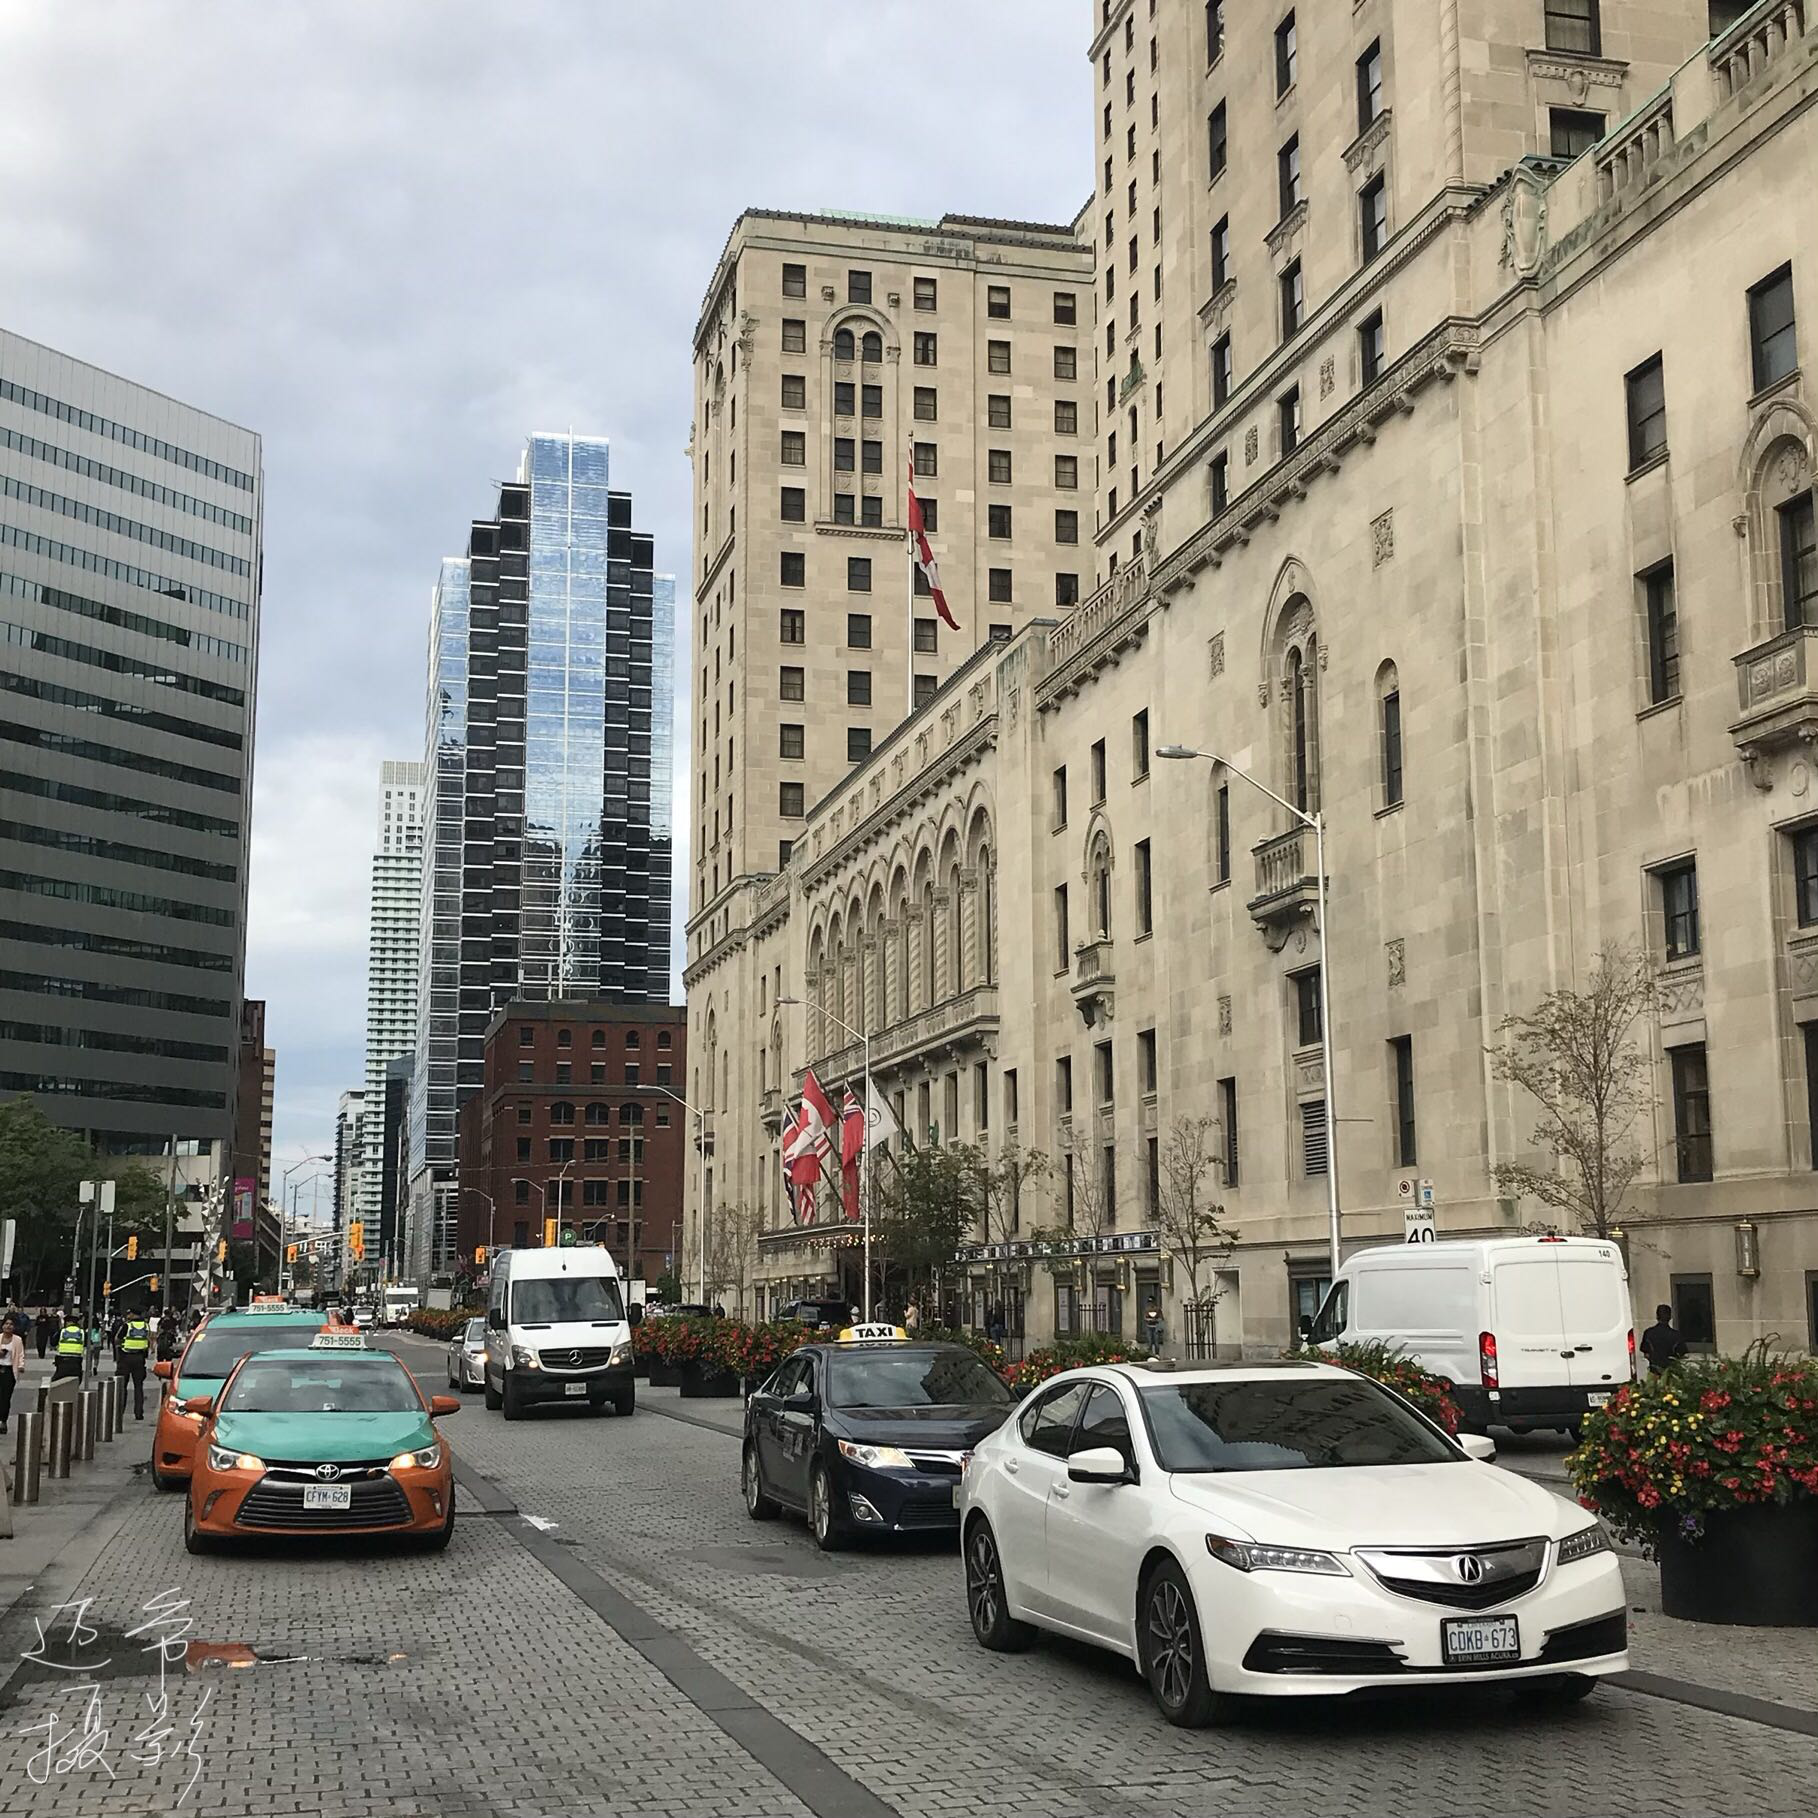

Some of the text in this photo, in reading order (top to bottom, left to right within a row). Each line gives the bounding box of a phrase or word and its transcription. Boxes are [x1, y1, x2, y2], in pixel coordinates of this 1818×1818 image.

[1405, 1213, 1433, 1221] MAXIMUM
[1407, 1227, 1435, 1244] 40
[1598, 1249, 1611, 1258] 140
[252, 1304, 285, 1313] 751-5555
[855, 1327, 893, 1339] TAXI
[318, 1336, 361, 1346] 751-5555
[1449, 1627, 1517, 1652] CDKB 673
